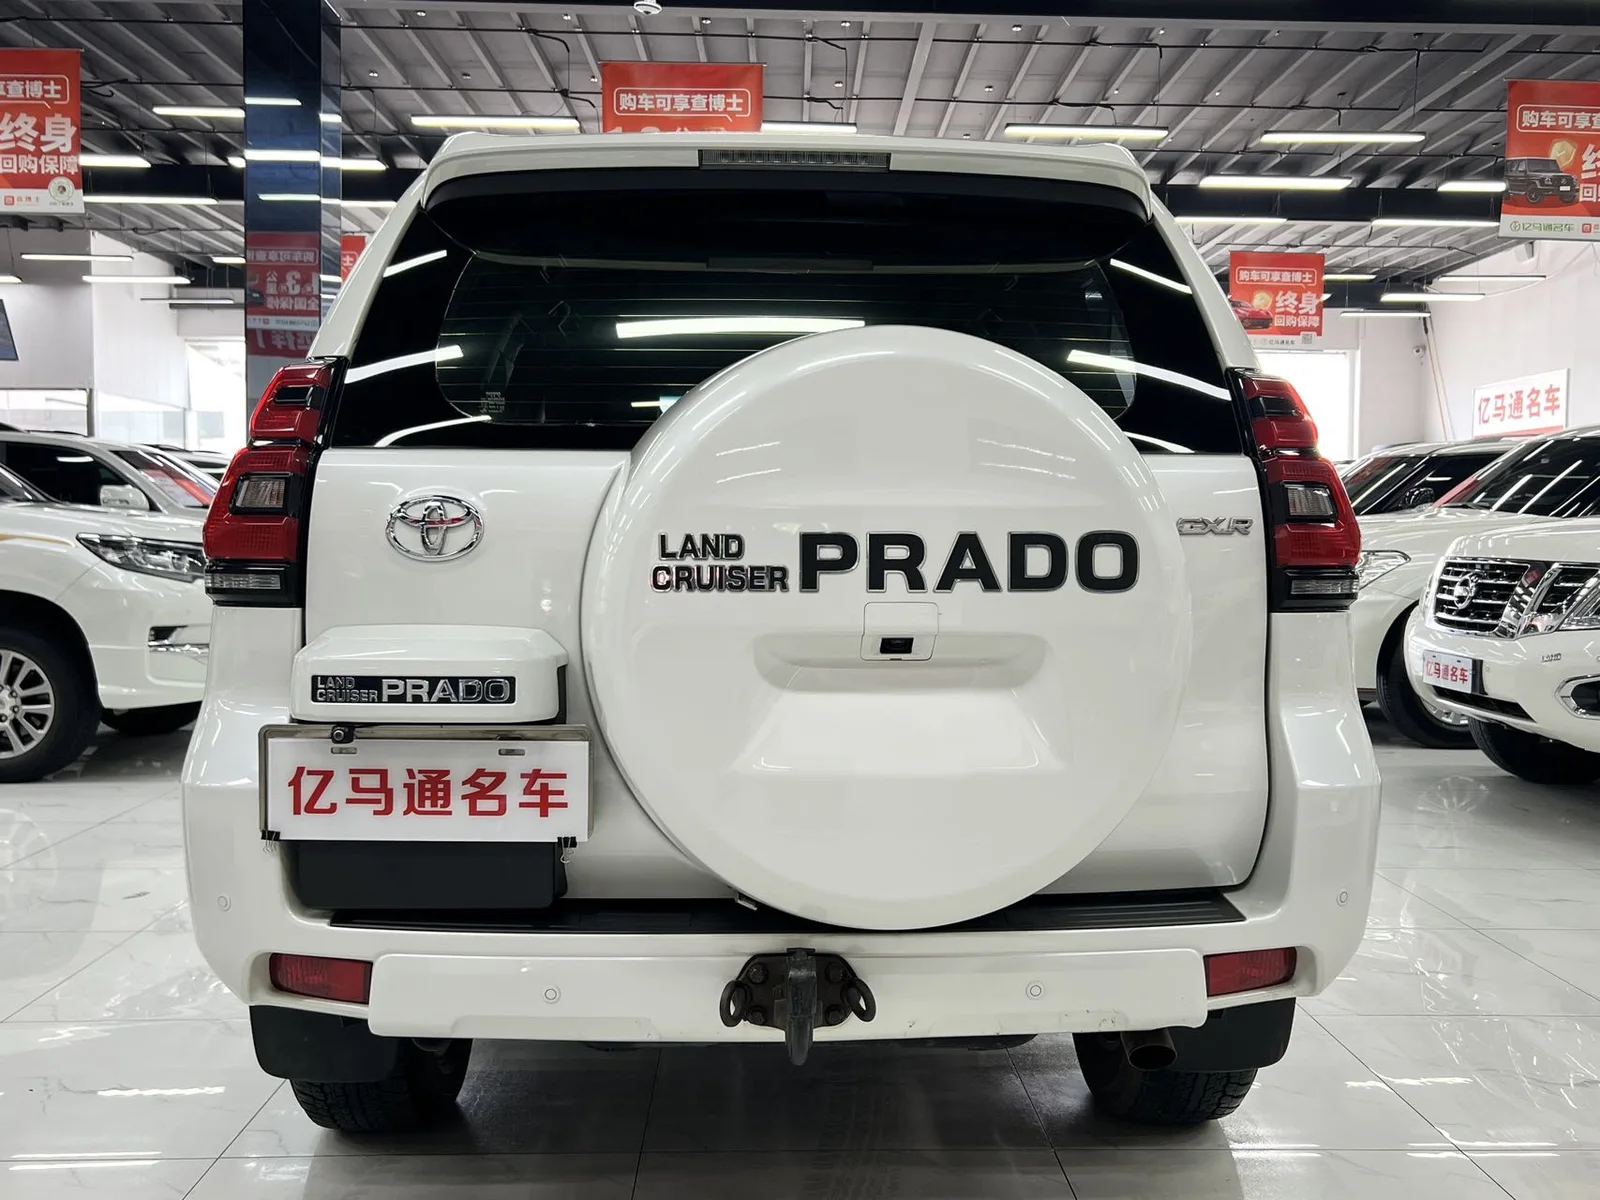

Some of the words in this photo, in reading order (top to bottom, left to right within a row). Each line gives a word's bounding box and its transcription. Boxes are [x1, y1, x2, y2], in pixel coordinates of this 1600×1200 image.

[619, 93, 743, 112] 购车可享查博士
[0, 112, 77, 153] 终身
[0, 154, 79, 175] 回购保障
[1239, 270, 1313, 283] 购车可享查博士
[1275, 290, 1320, 315] 终身
[1274, 314, 1320, 327] 回购保障
[1478, 384, 1560, 425] 亿马通名车
[657, 532, 746, 560] LAND
[799, 530, 1141, 594] PRADO
[650, 563, 790, 593] CRUISER
[316, 676, 356, 689] LAND
[1426, 660, 1468, 684] 亿马通名车
[316, 689, 379, 702] CRUISER
[381, 678, 511, 703] PRADO
[287, 766, 569, 818] 亿马通名车
